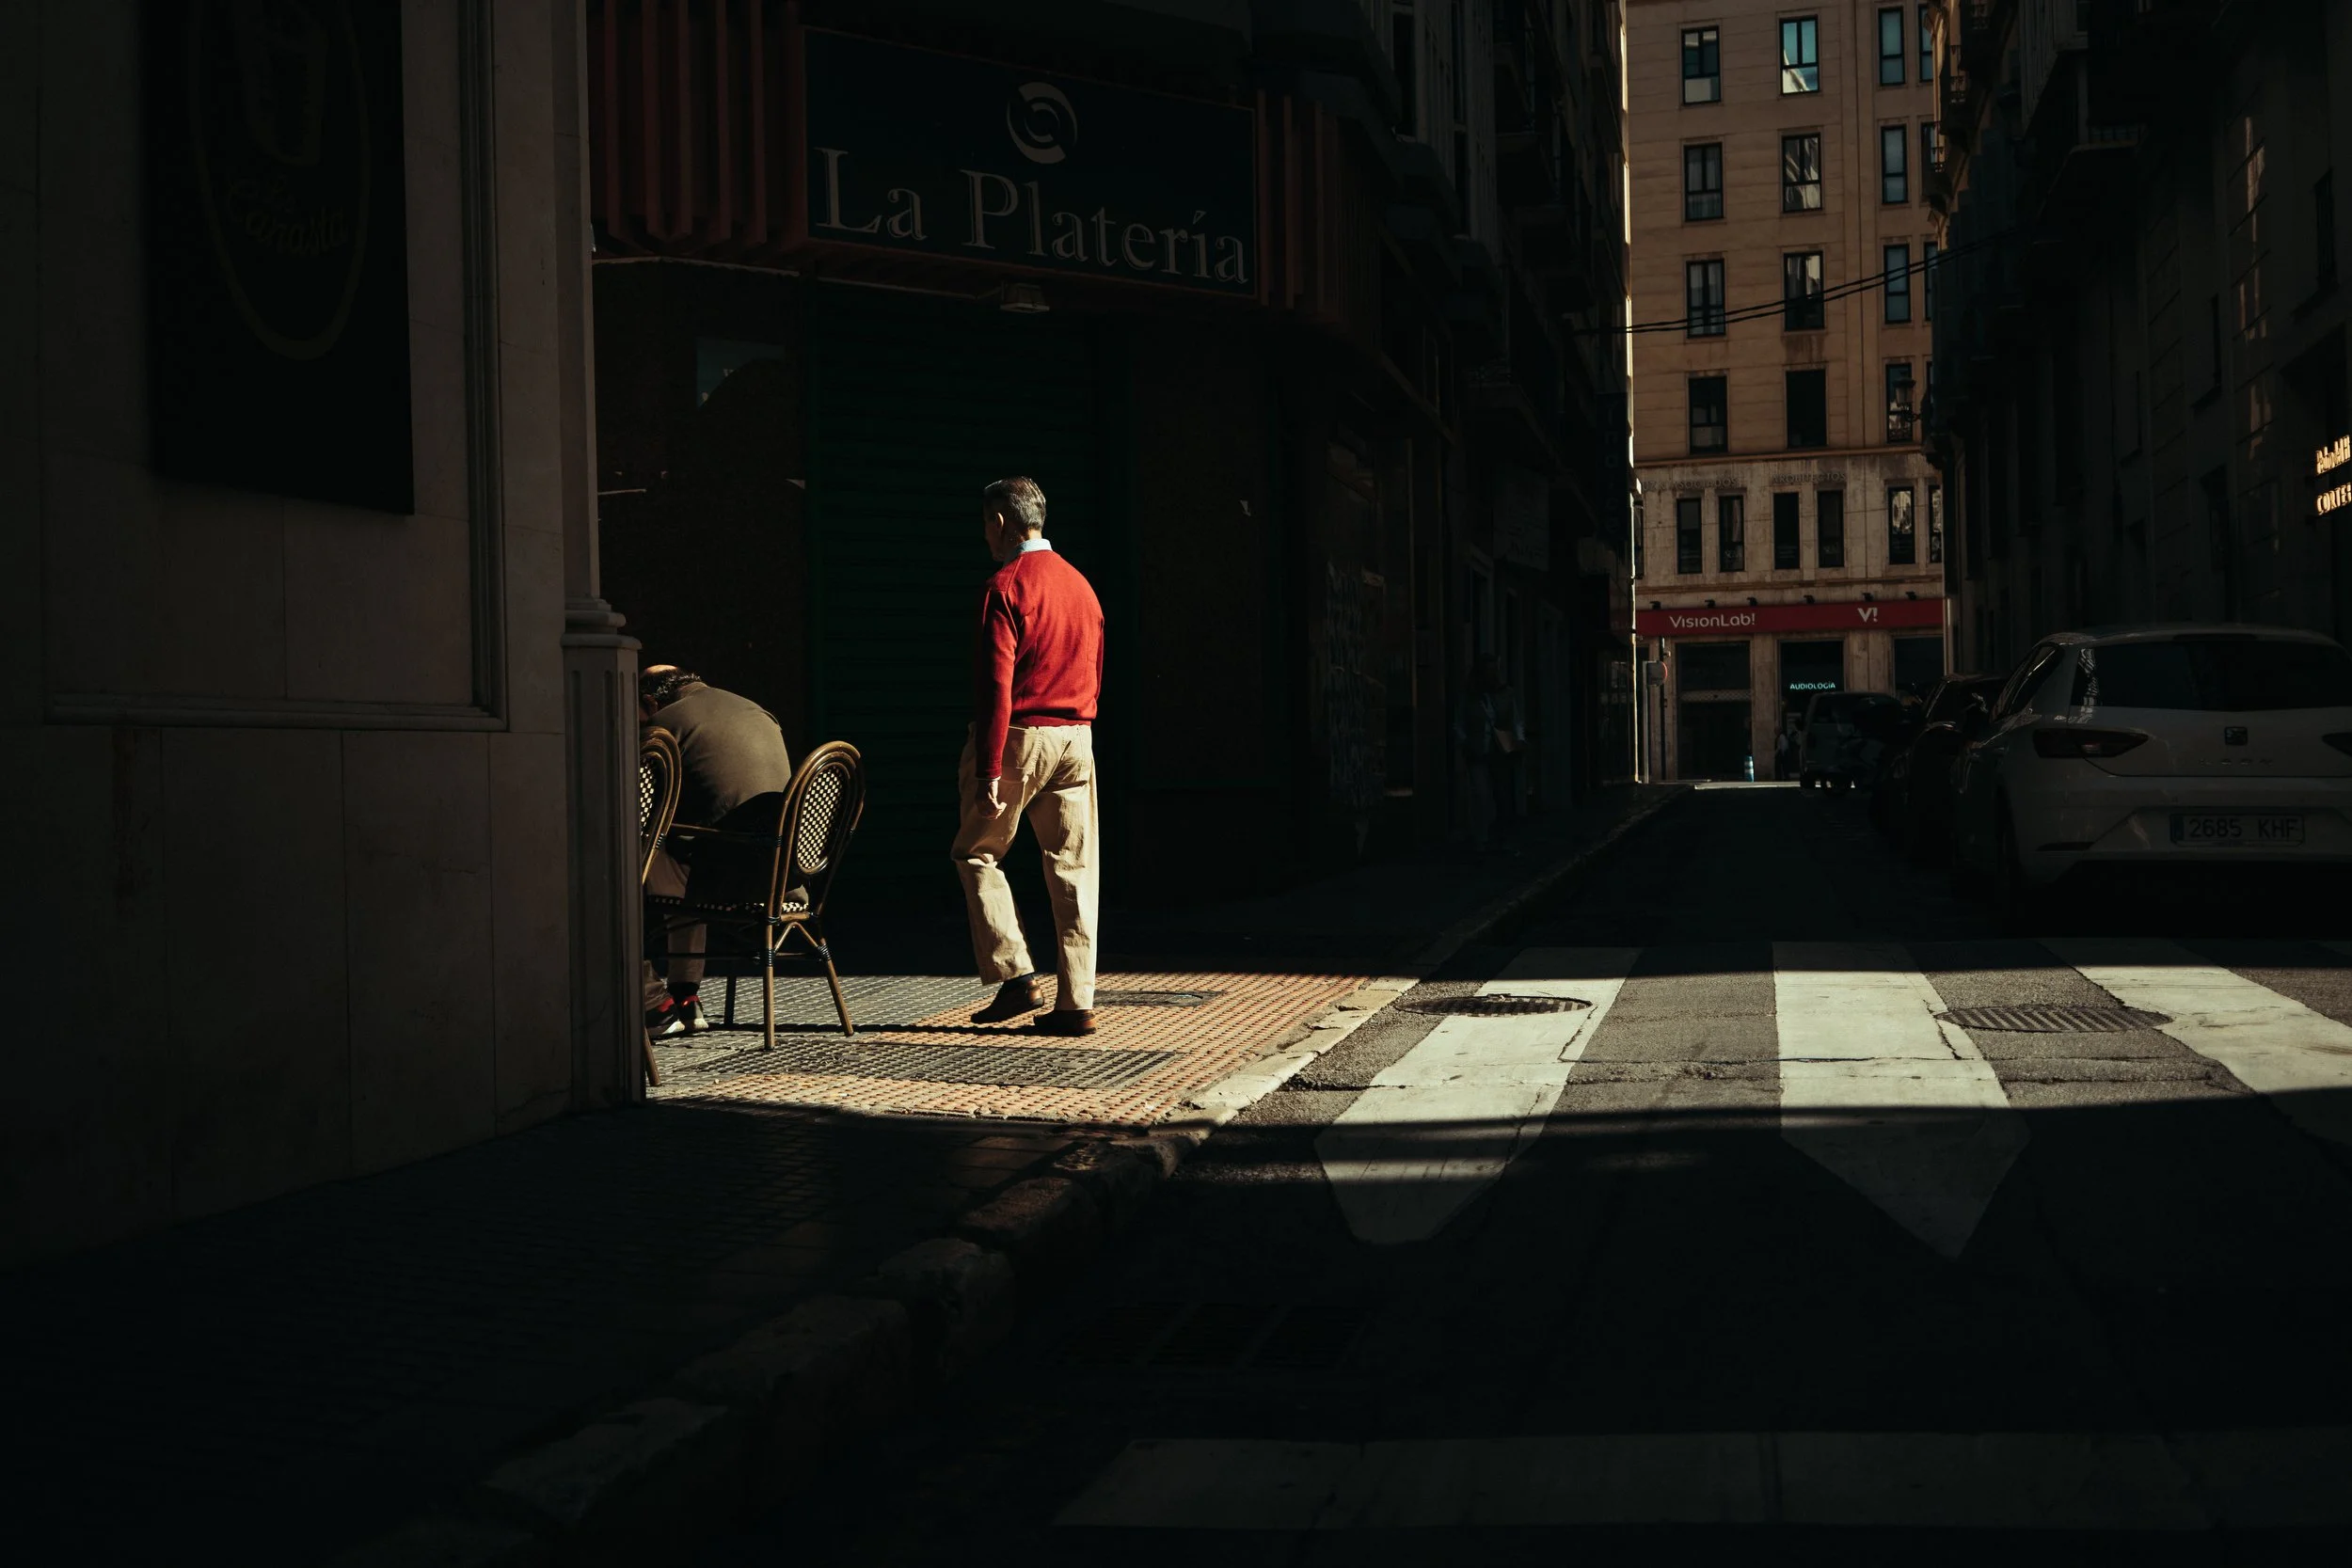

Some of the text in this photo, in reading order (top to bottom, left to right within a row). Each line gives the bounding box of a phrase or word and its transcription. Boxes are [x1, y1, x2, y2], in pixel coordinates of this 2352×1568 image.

[813, 147, 1248, 284] La Platería
[1669, 612, 1756, 629] VisionLab!
[1857, 607, 1879, 623] V!
[2189, 817, 2298, 838] 2685 KHF
